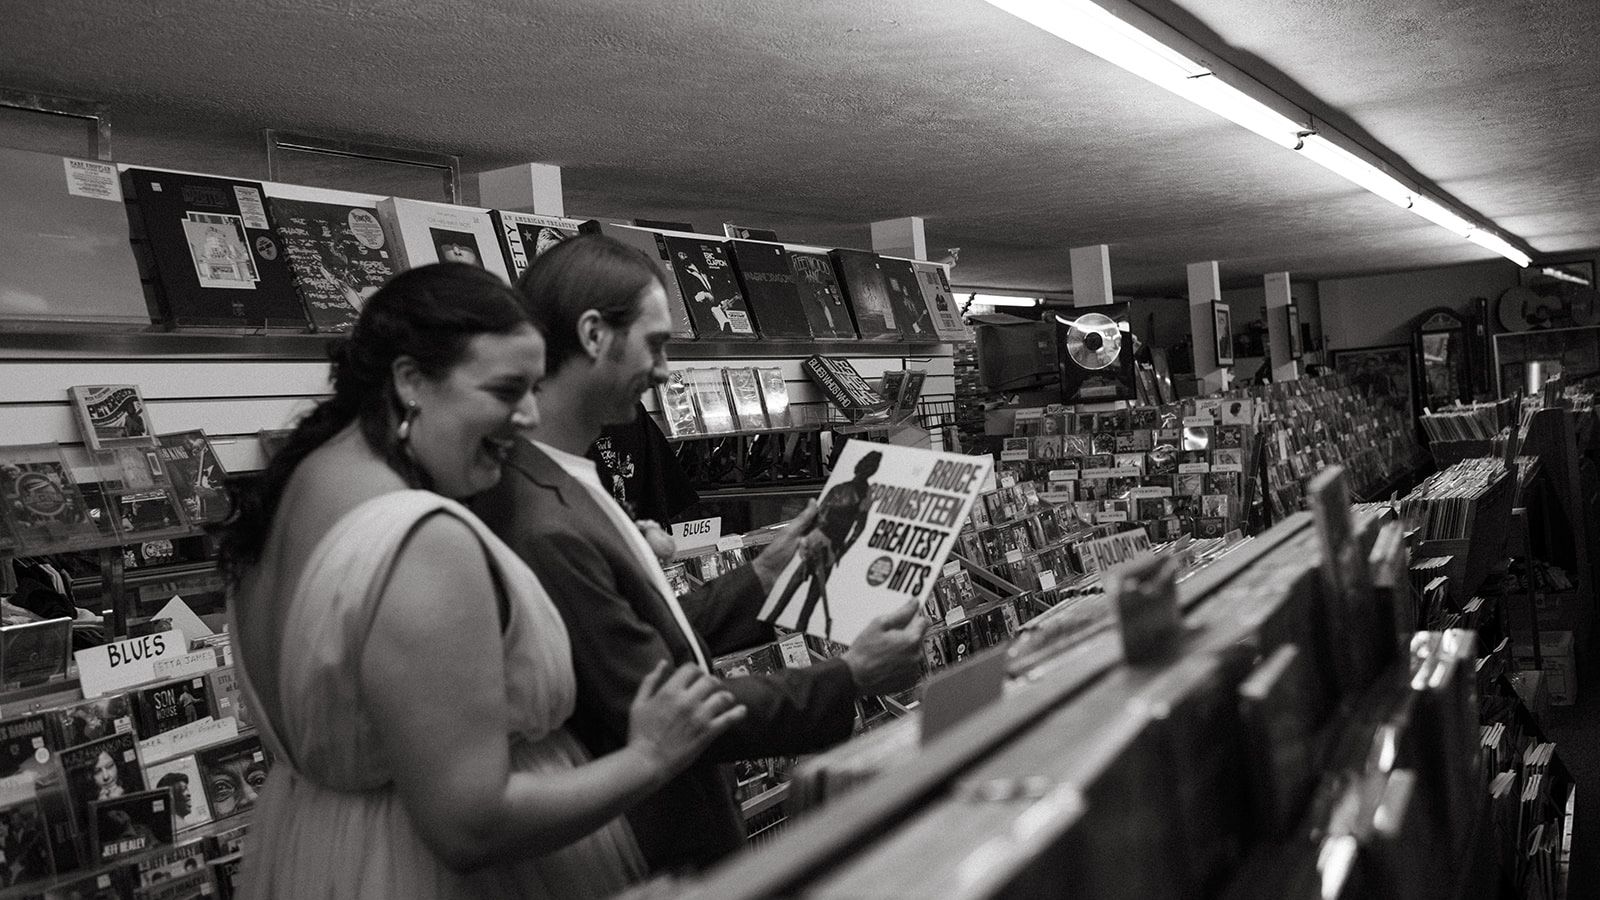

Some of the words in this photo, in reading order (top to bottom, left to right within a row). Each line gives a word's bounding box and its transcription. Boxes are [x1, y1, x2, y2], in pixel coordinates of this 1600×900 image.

[925, 459, 983, 494] BRUCE
[869, 482, 966, 528] SPRINGSTEEN
[683, 519, 711, 538] BLUES
[868, 518, 950, 563] GREATEST
[887, 559, 932, 597] HITS
[107, 634, 166, 668] BLUES
[184, 651, 214, 665] JAMES
[153, 688, 176, 710] SON
[156, 704, 178, 721] HOUSE
[102, 844, 119, 858] JEFF
[119, 837, 147, 854] HEALEY
